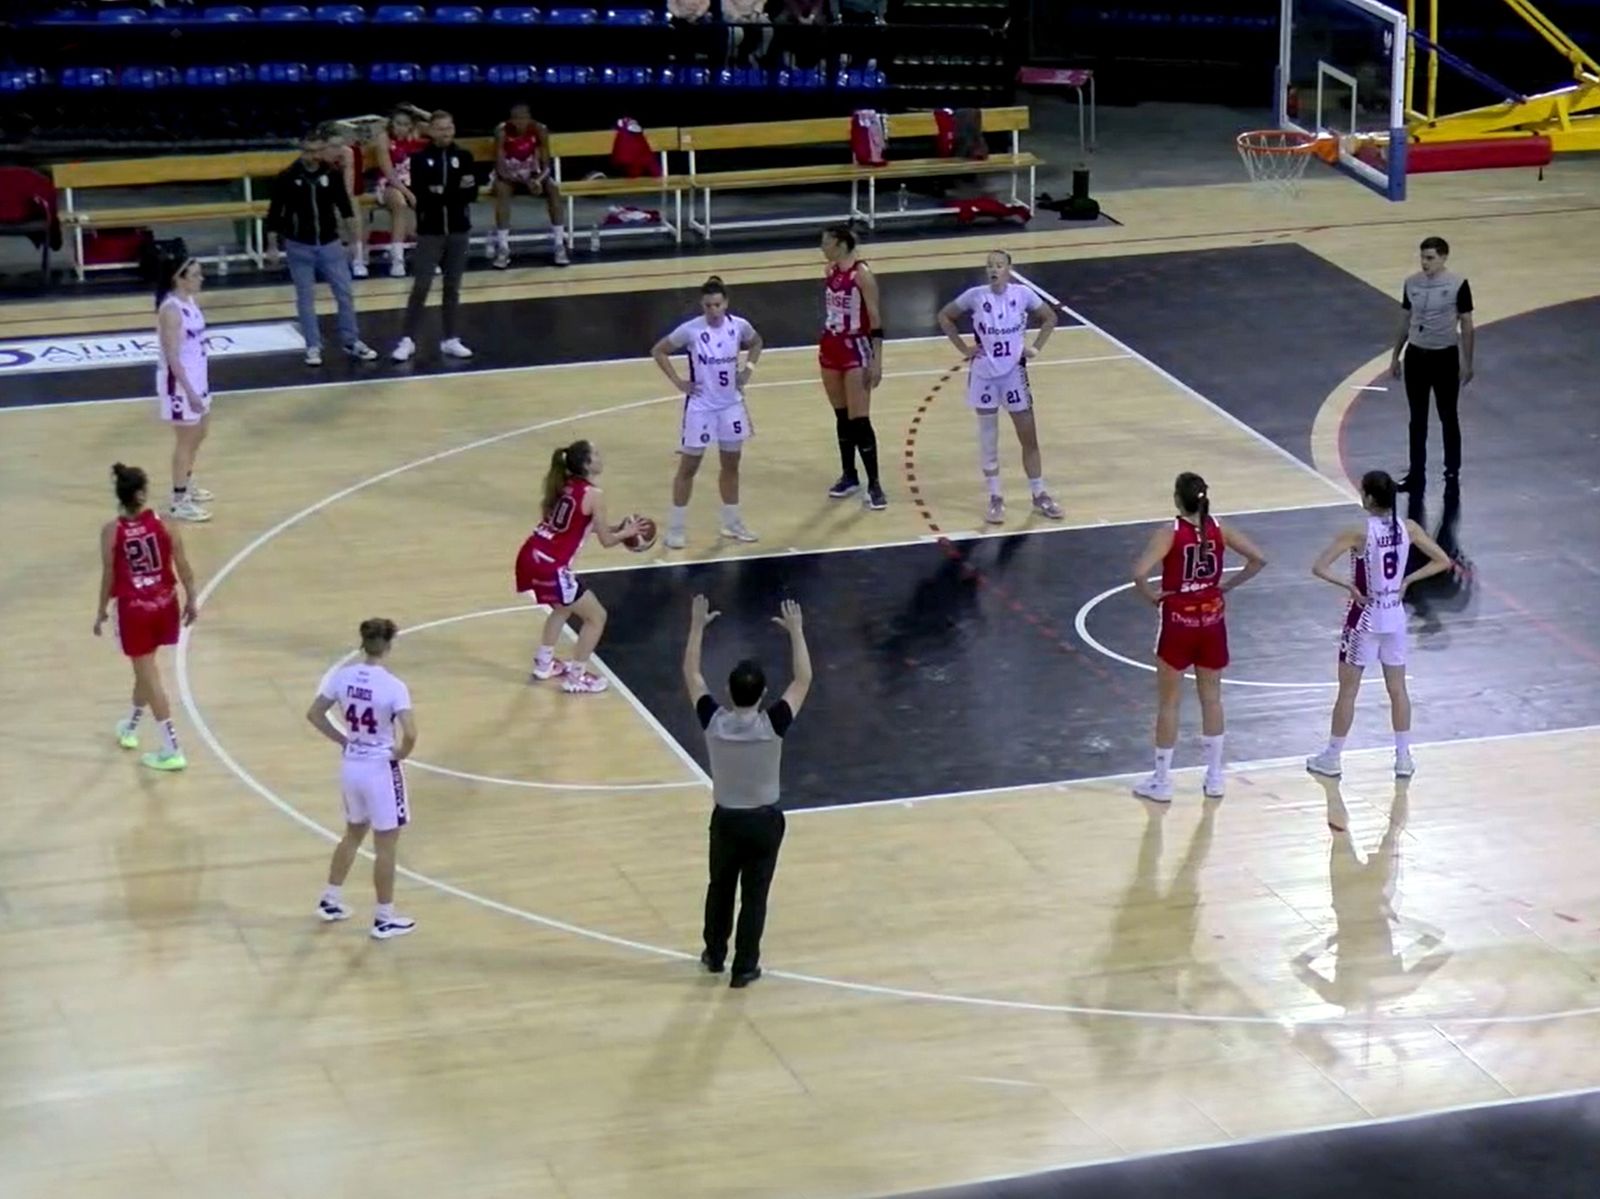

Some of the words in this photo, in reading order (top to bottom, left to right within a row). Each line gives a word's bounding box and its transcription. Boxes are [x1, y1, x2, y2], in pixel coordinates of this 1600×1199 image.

[993, 341, 1012, 358] 21
[719, 371, 729, 387] 5
[1007, 390, 1021, 404] 21
[733, 421, 742, 434] 5
[124, 532, 162, 574] 21
[1183, 540, 1217, 581] 15
[345, 704, 378, 734] 44
